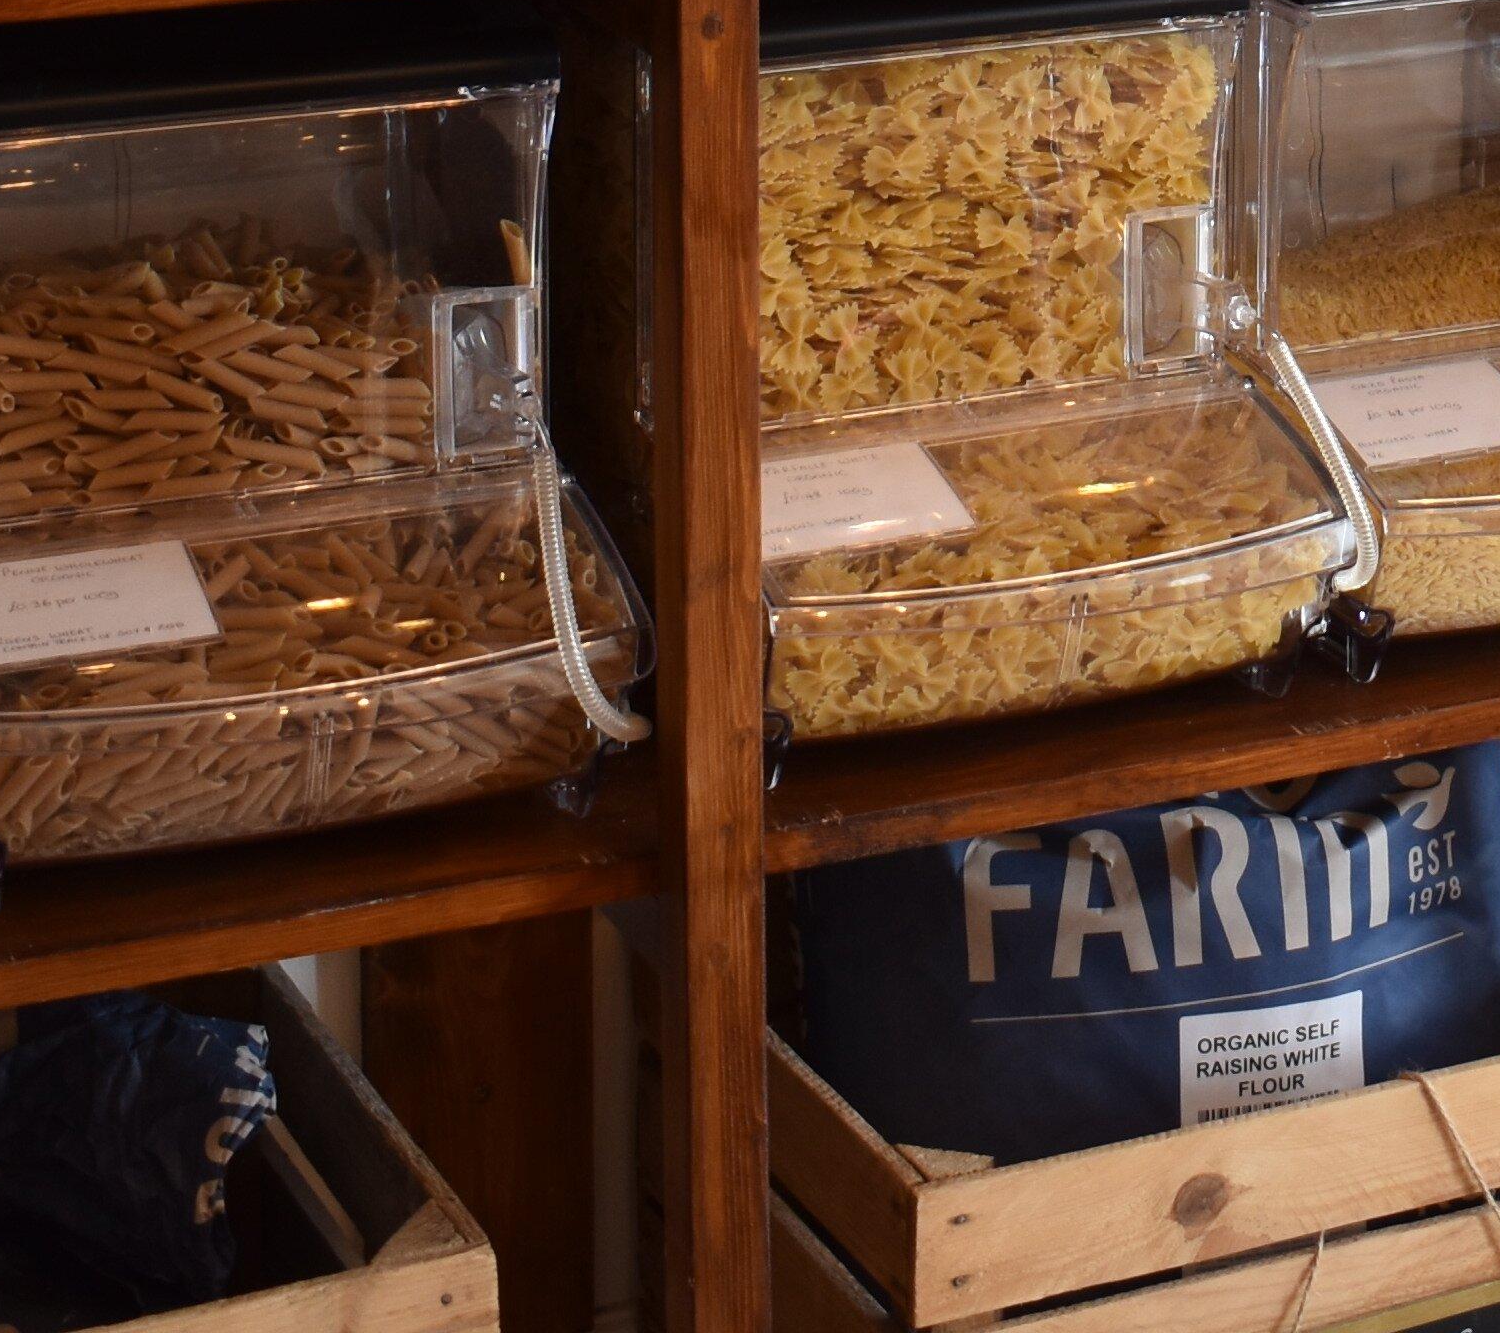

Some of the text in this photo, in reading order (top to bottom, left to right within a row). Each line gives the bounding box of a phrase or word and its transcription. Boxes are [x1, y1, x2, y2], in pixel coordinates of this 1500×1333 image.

[1407, 875, 1462, 916] 1978
[1196, 1018, 1341, 1055] ORGANIC SELF
[1194, 1040, 1343, 1080] RAISING WHITE
[1237, 1071, 1306, 1099] FLOUR
